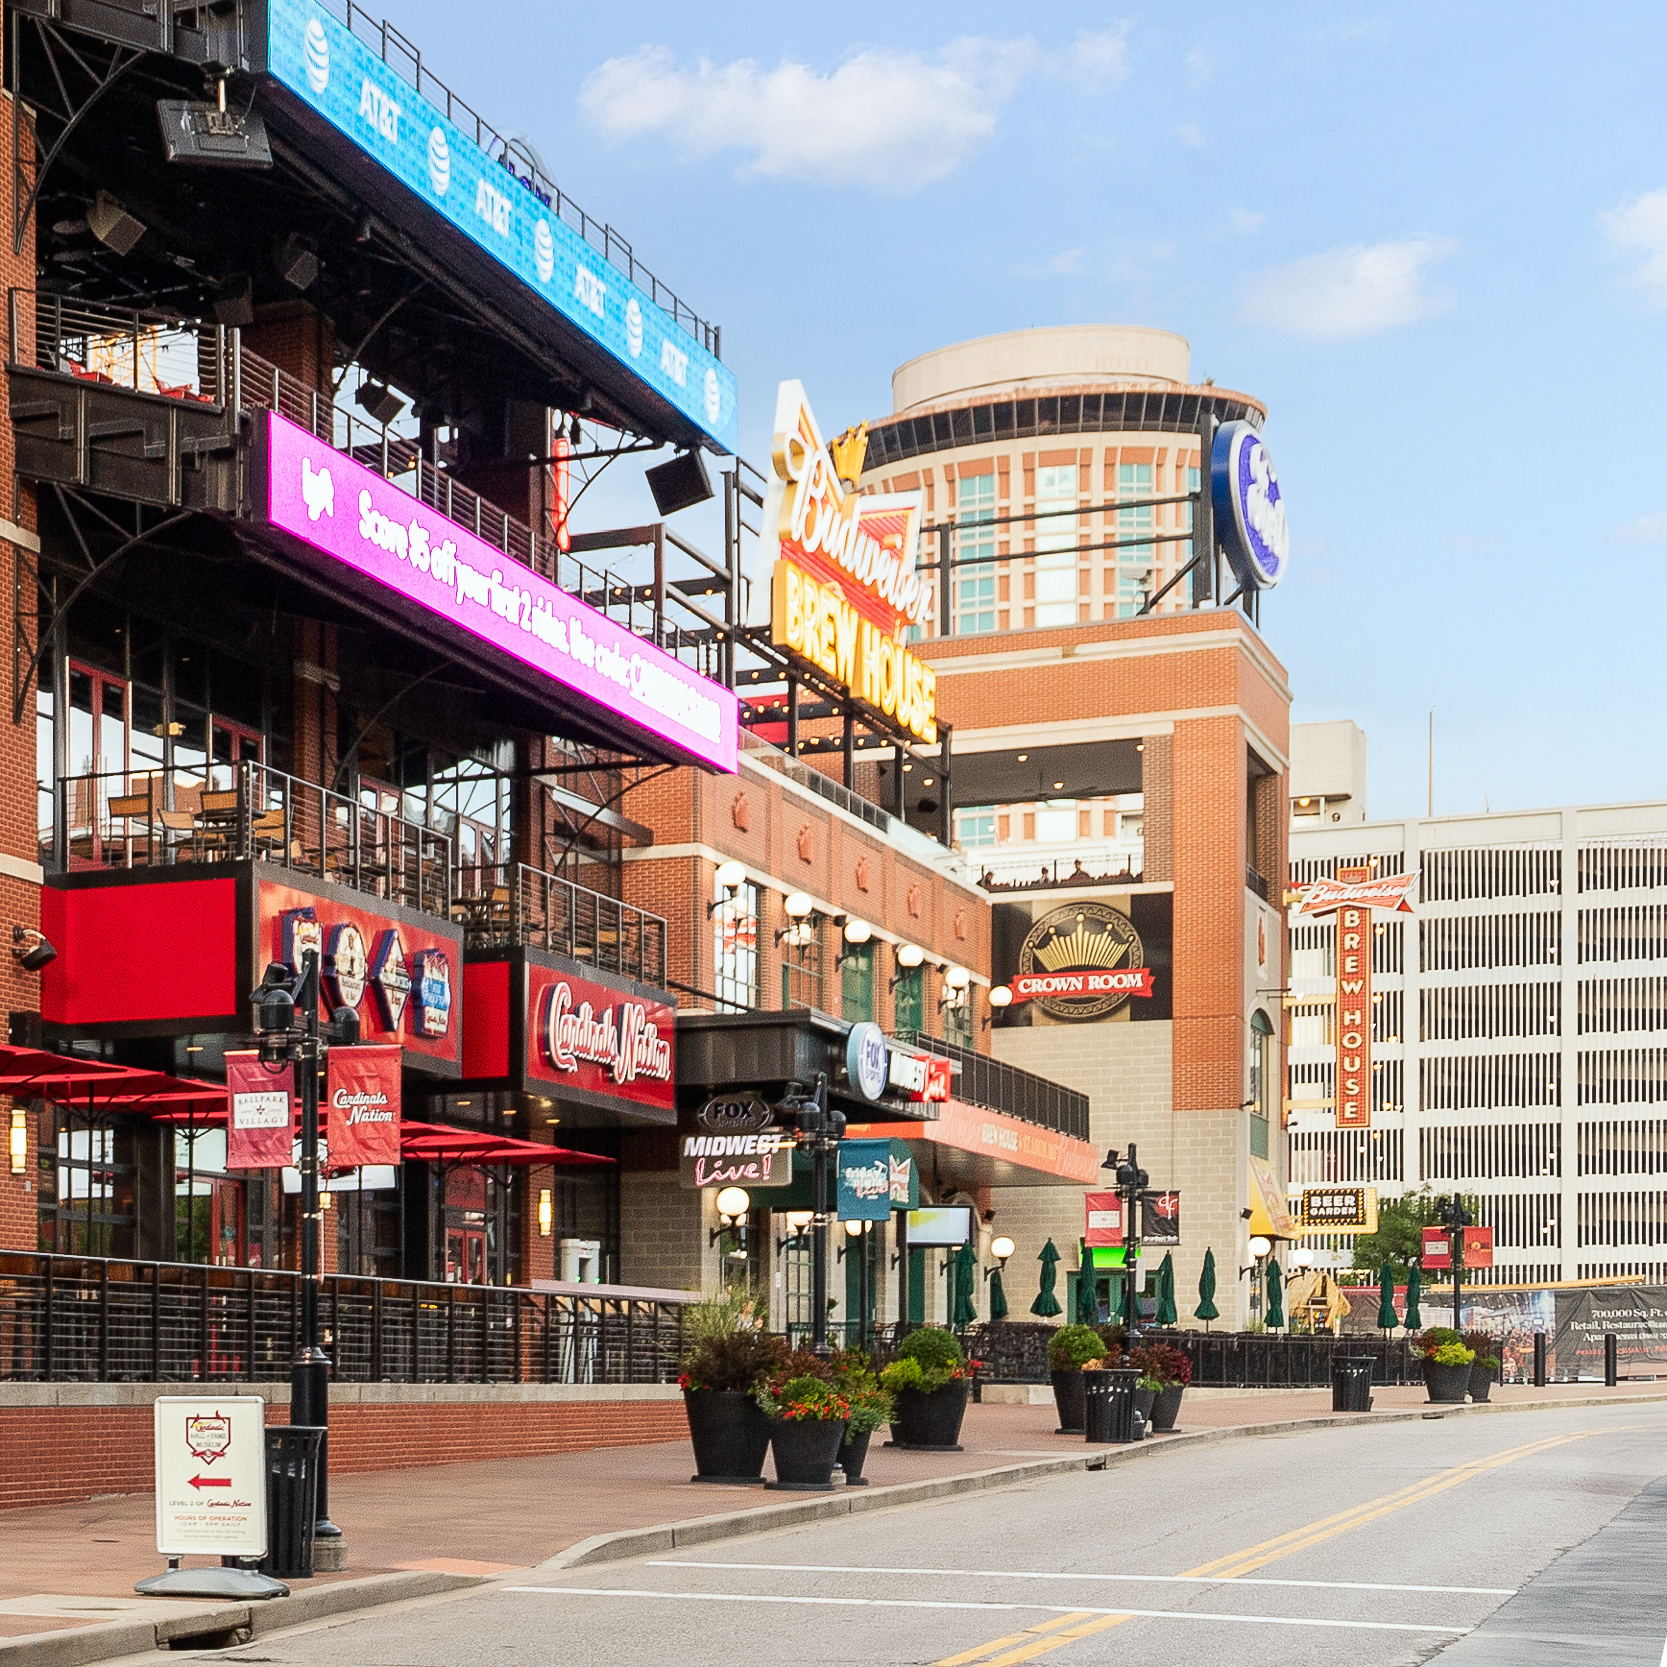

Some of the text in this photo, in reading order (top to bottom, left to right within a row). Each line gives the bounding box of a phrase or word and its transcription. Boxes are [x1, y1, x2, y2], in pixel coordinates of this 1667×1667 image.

[360, 78, 401, 145] AT&T
[475, 178, 512, 237] AT&T
[573, 264, 607, 319] AT&T
[773, 432, 932, 624] Budweiser
[785, 563, 858, 686] BREW
[861, 617, 937, 745] HOUSE
[1305, 884, 1414, 904] Budweiser
[1019, 973, 1143, 994] CROWN ROOM
[1341, 910, 1363, 1119] BREW HOUSE
[549, 982, 618, 1073] Cardinals
[614, 1002, 671, 1084] Nation
[238, 1096, 286, 1106] BALLPARK
[333, 1088, 388, 1109] Cardinals
[240, 1116, 283, 1125] VILLAGE
[346, 1105, 393, 1126] Nation
[684, 1135, 781, 1156] MIDWEST
[695, 1154, 771, 1186] Live!
[1310, 1196, 1356, 1207] BEER
[1310, 1207, 1357, 1216] GARDEN
[1591, 1310, 1632, 1318] 700,000
[1650, 1308, 1663, 1317] Ft.
[1570, 1322, 1601, 1331] Retail,
